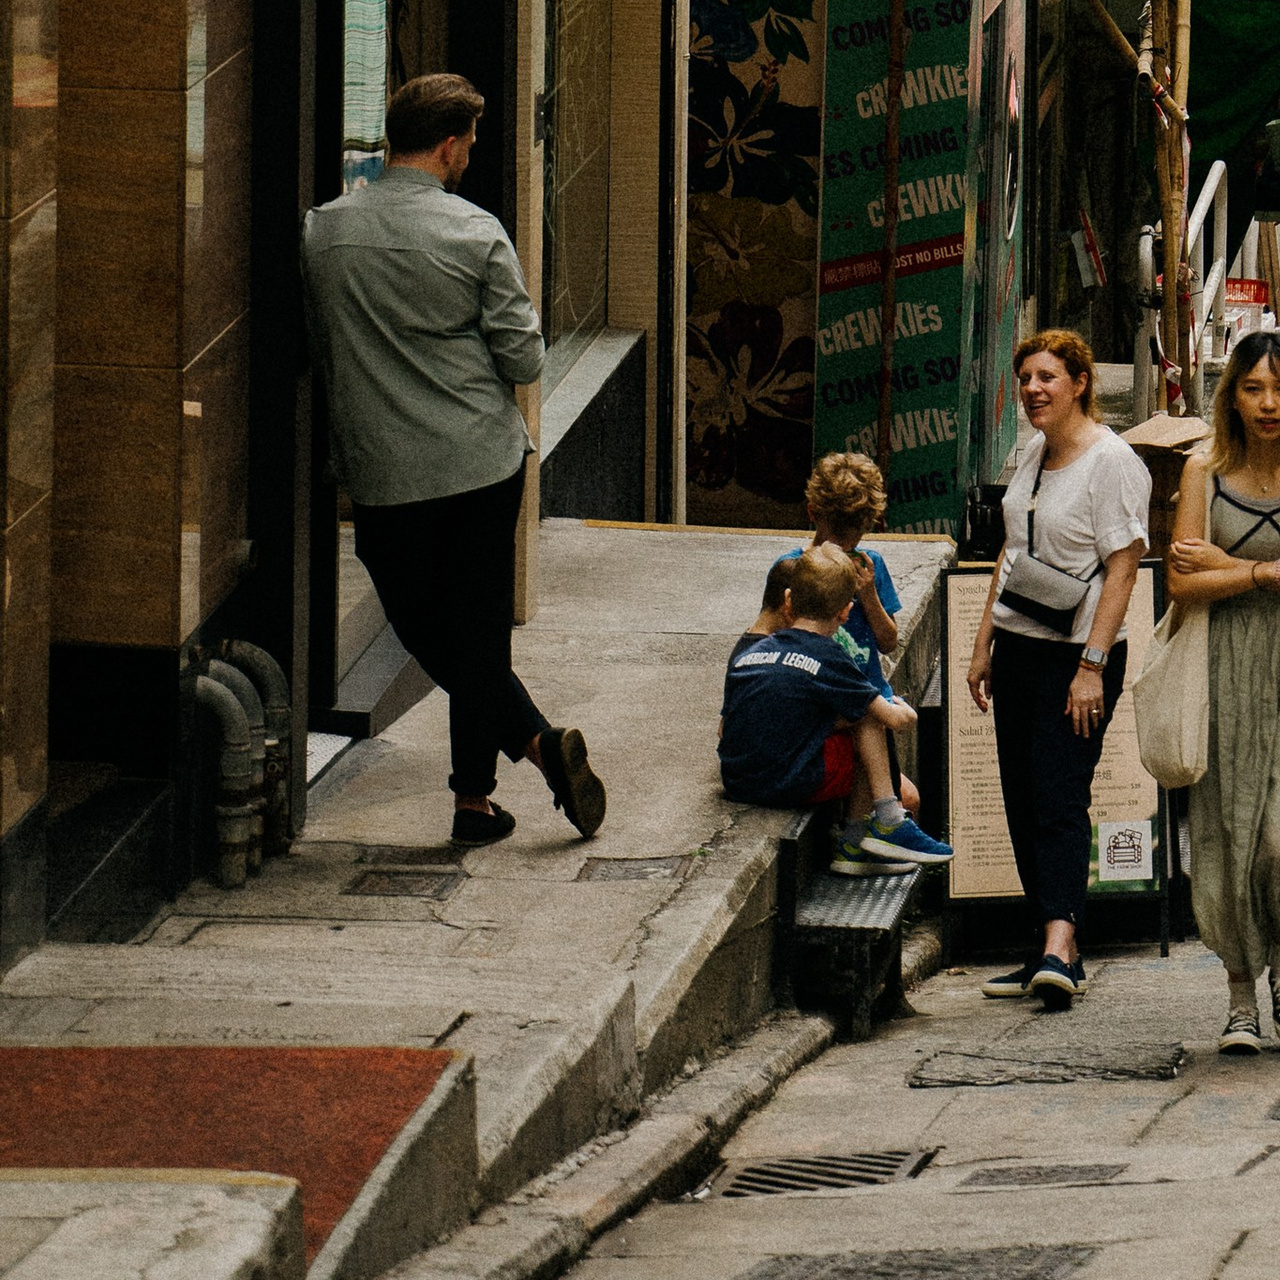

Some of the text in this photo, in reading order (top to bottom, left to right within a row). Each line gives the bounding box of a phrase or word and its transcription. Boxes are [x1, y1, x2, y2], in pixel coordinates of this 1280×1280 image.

[832, 6, 931, 51] COMNG
[856, 64, 968, 119] CRWKIE
[867, 173, 968, 228] CEWKI
[915, 250, 932, 264] NO
[934, 243, 964, 260] BILLS
[821, 355, 961, 409] COMNG SO
[845, 408, 959, 457] CRWKIE
[957, 584, 990, 596] Spaghe
[782, 651, 821, 676] LEGION
[959, 726, 983, 737] Salad
